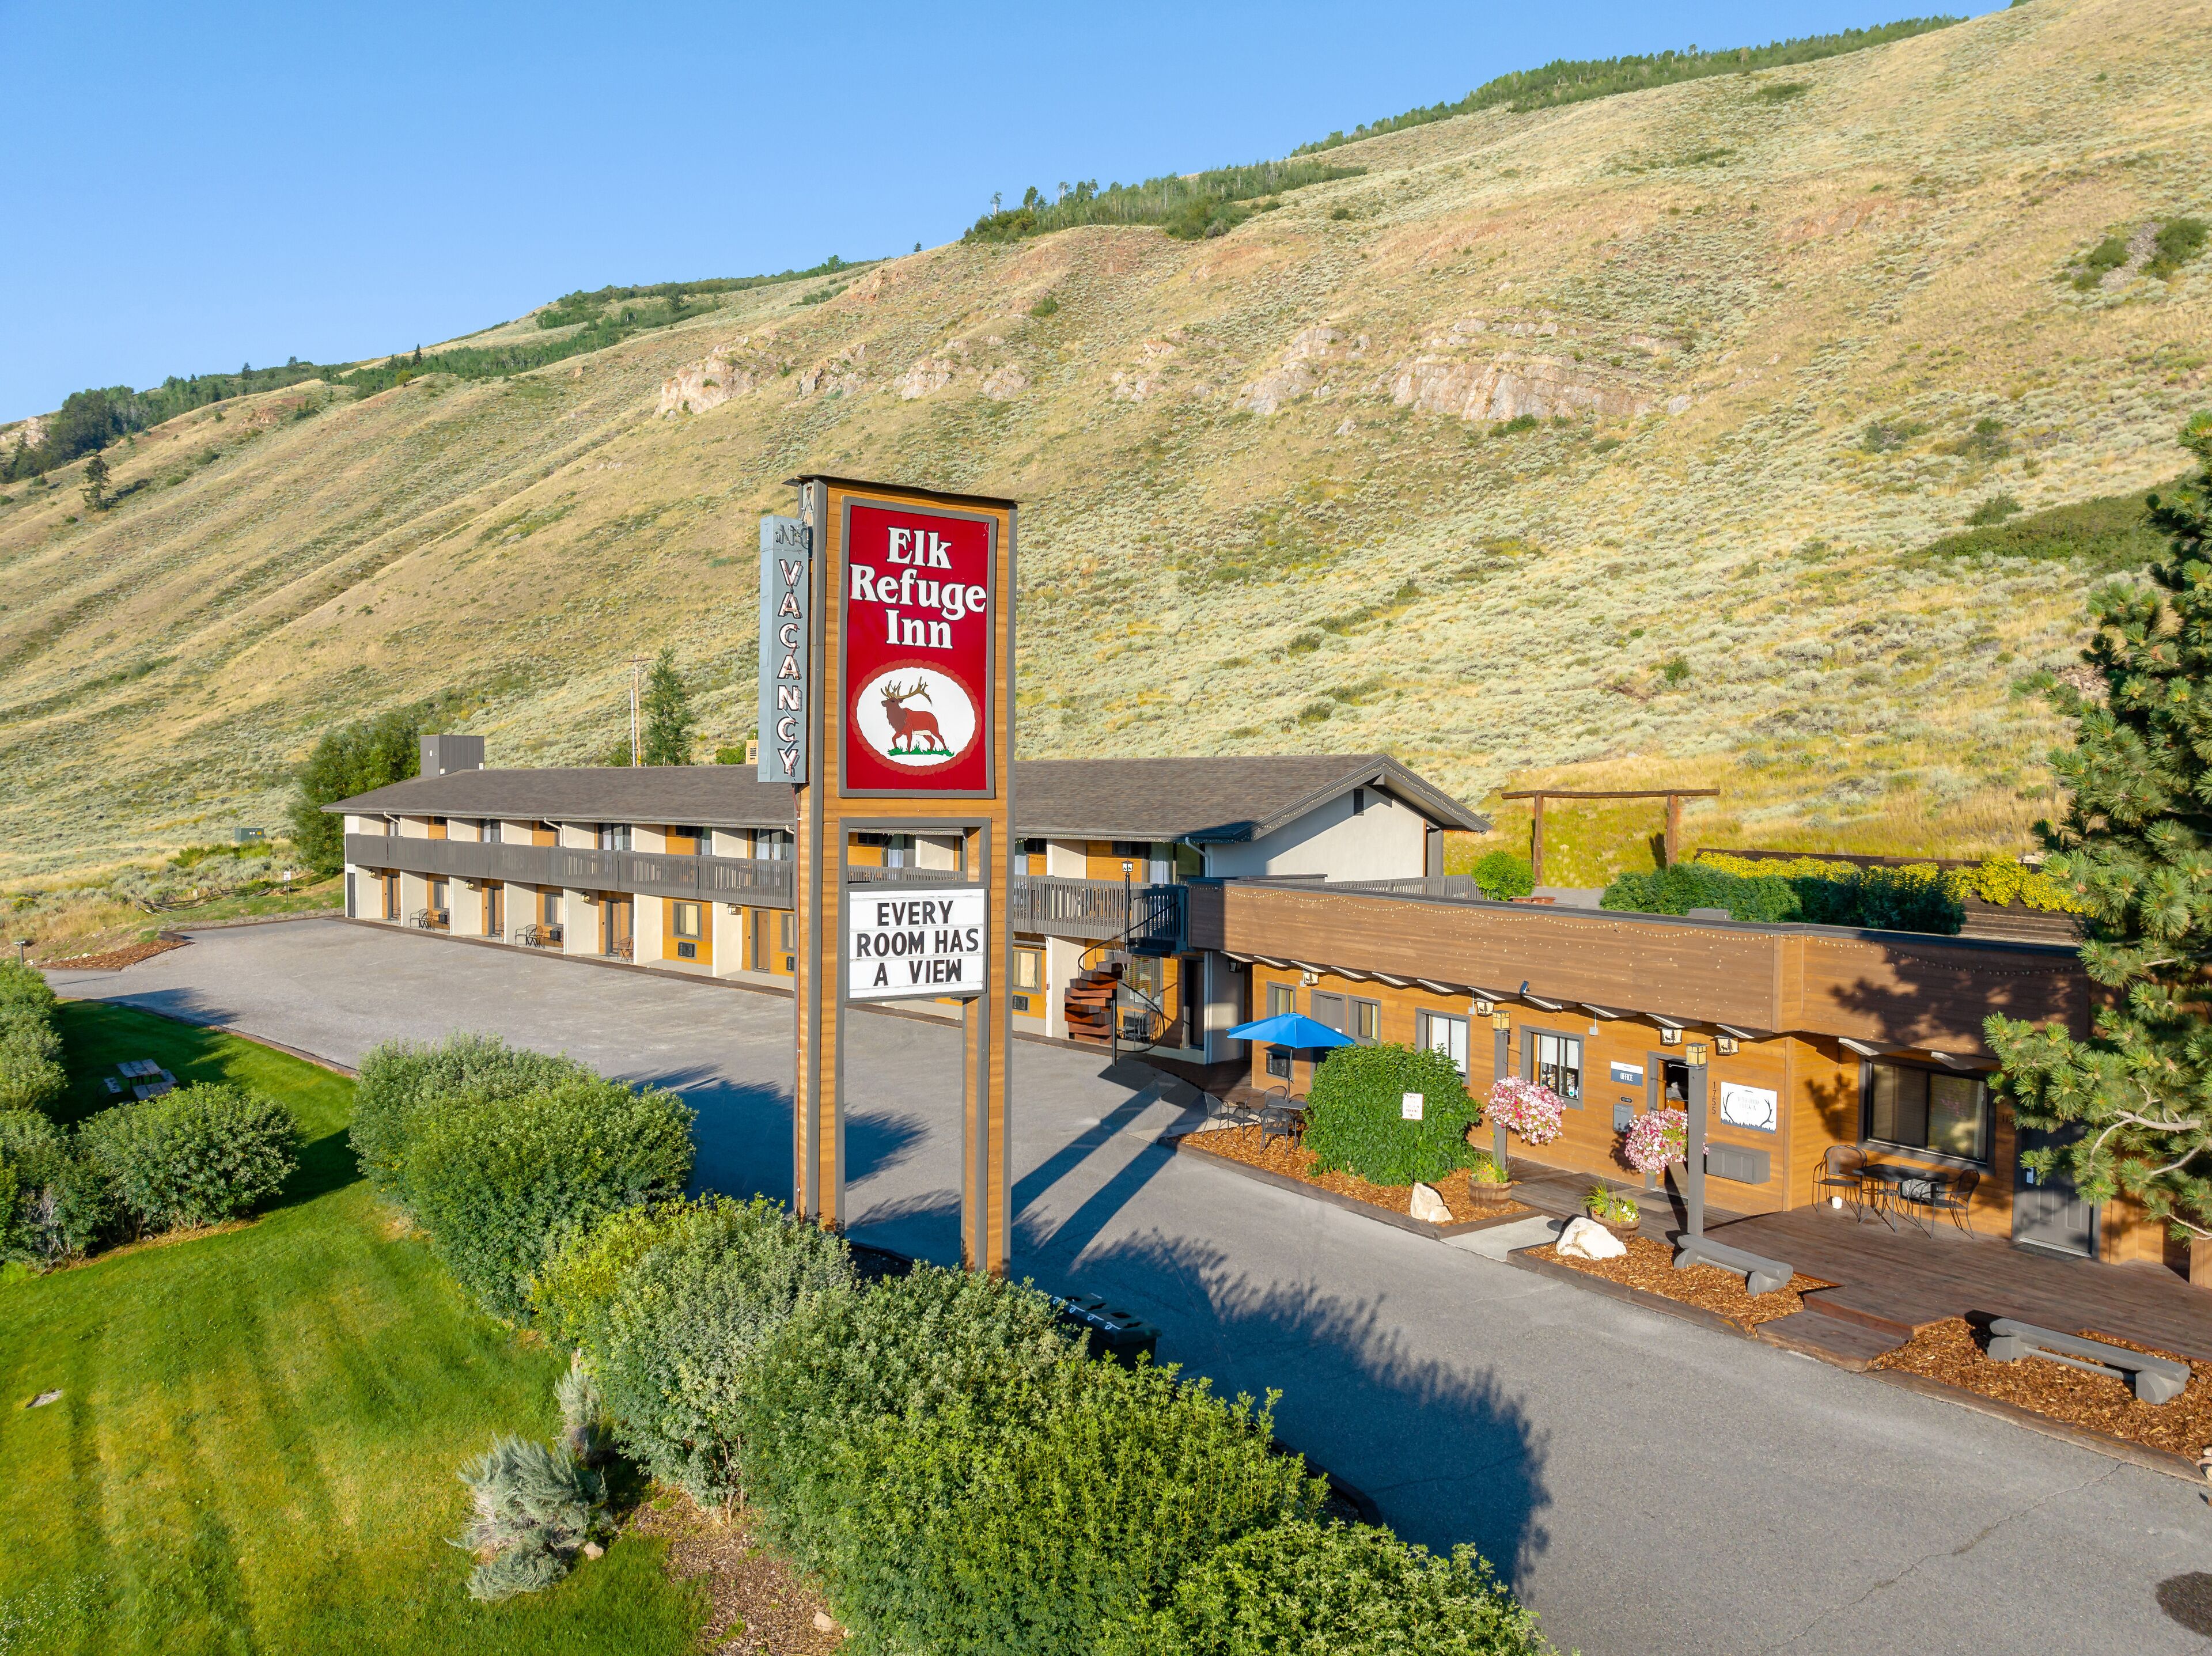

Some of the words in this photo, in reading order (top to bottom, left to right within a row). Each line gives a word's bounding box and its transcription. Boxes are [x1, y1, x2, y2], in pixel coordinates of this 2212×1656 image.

[887, 525, 952, 569] Elk
[850, 563, 987, 620] Refuge
[886, 609, 953, 649] Inn
[777, 559, 801, 776] VACANCY
[877, 900, 953, 926] EVERY
[857, 931, 925, 957] ROOM
[935, 928, 979, 953] HAS
[873, 962, 889, 987] A
[908, 958, 961, 984] VIEW
[1620, 1073, 1633, 1082] OFFICE
